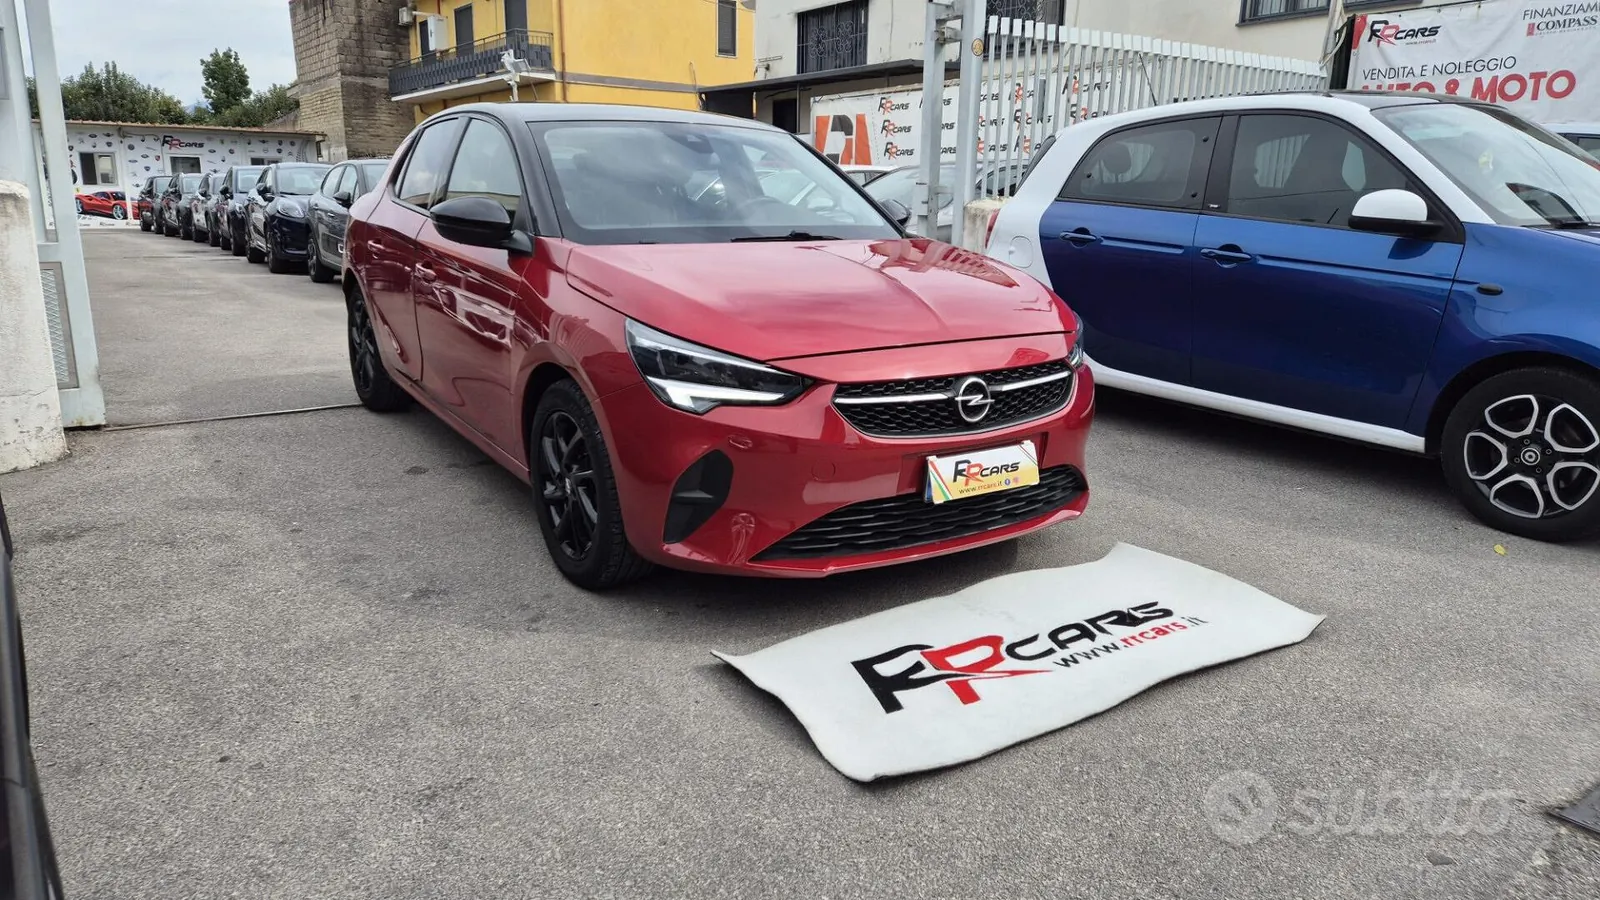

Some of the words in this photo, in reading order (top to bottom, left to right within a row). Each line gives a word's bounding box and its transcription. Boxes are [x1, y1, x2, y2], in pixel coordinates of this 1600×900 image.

[1522, 2, 1600, 20] FINANZIAM
[1537, 15, 1598, 32] COMPASS
[1362, 66, 1416, 81] VENDITA
[1420, 64, 1427, 77] E
[1432, 55, 1517, 77] NOLEGGIO
[1470, 70, 1577, 103] MOTO
[1053, 615, 1208, 668] www.rrcars.it
